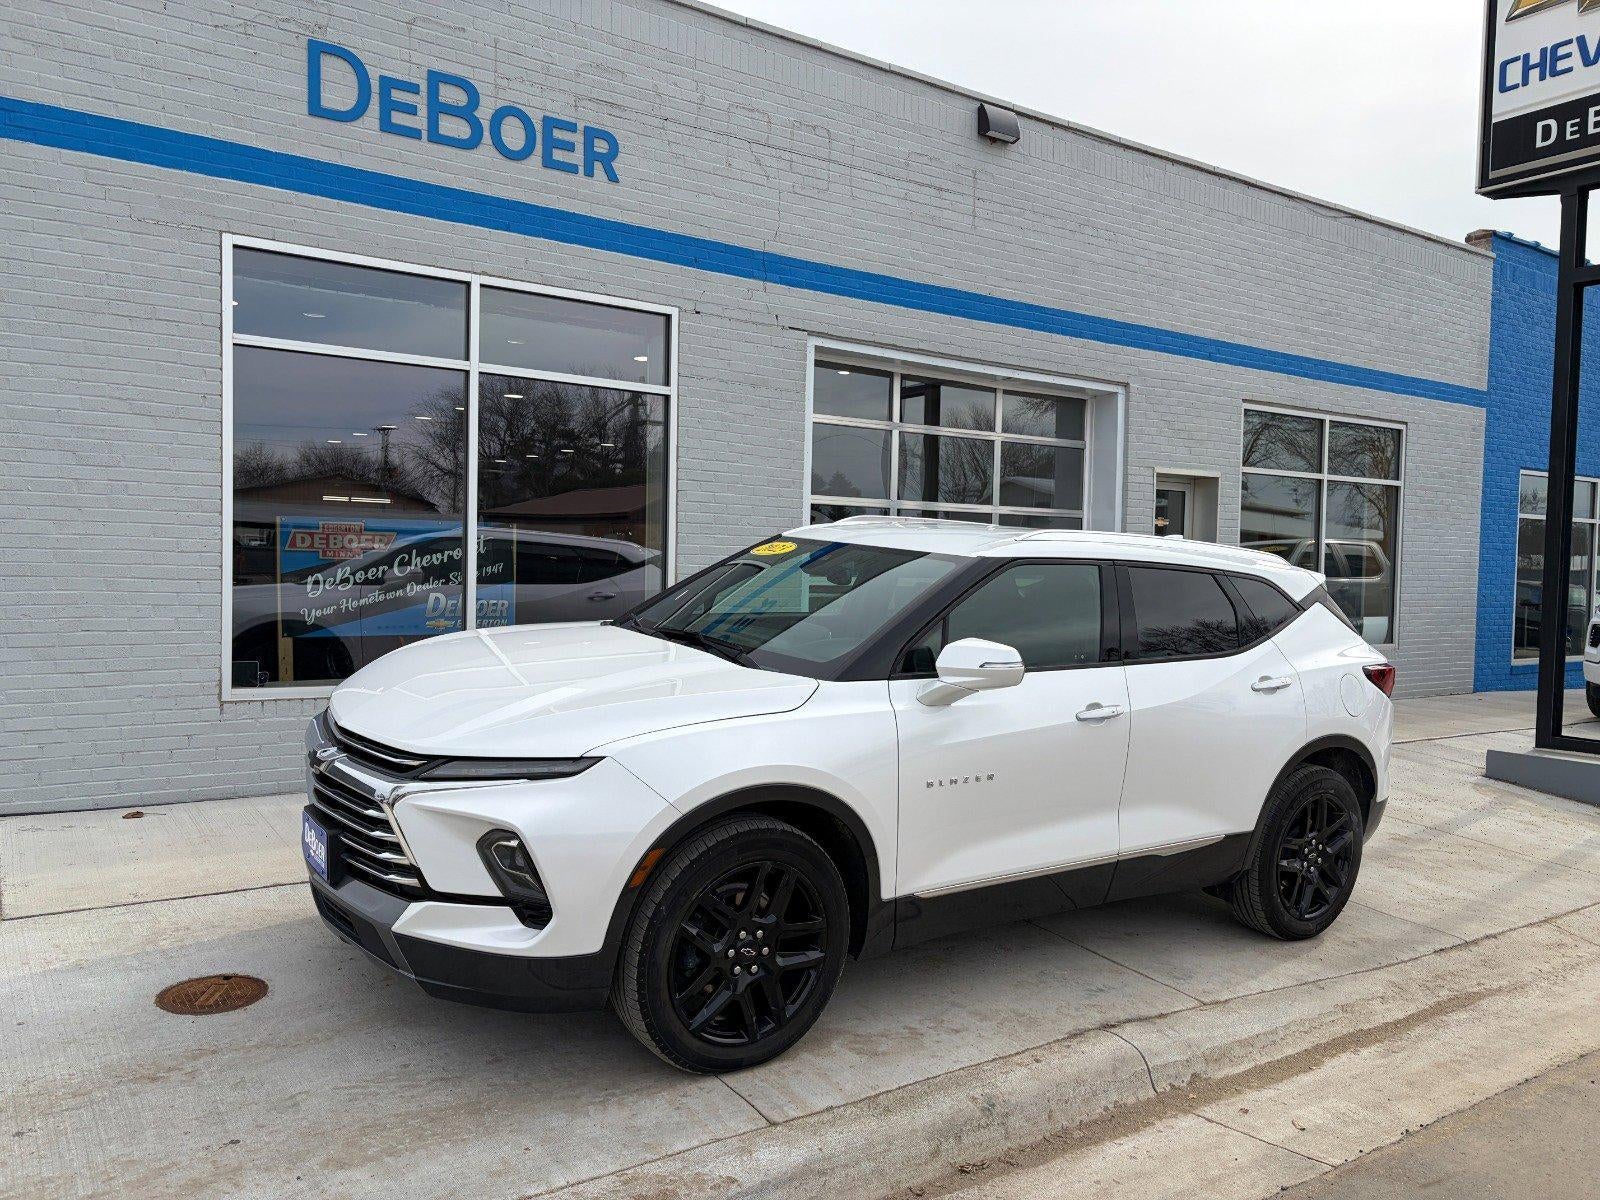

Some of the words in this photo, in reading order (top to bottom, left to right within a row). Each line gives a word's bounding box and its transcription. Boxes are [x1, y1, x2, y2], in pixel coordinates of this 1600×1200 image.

[294, 532, 389, 551] DEBOER
[299, 564, 388, 598] DeBoer
[393, 534, 494, 576] Chevrot
[300, 605, 337, 626] Your
[339, 590, 404, 613] Hometown
[406, 576, 445, 597] Dealer
[482, 562, 504, 577] 1947
[425, 592, 509, 617] DEOER
[456, 619, 508, 629] EERTON
[926, 773, 995, 789] BLAZER
